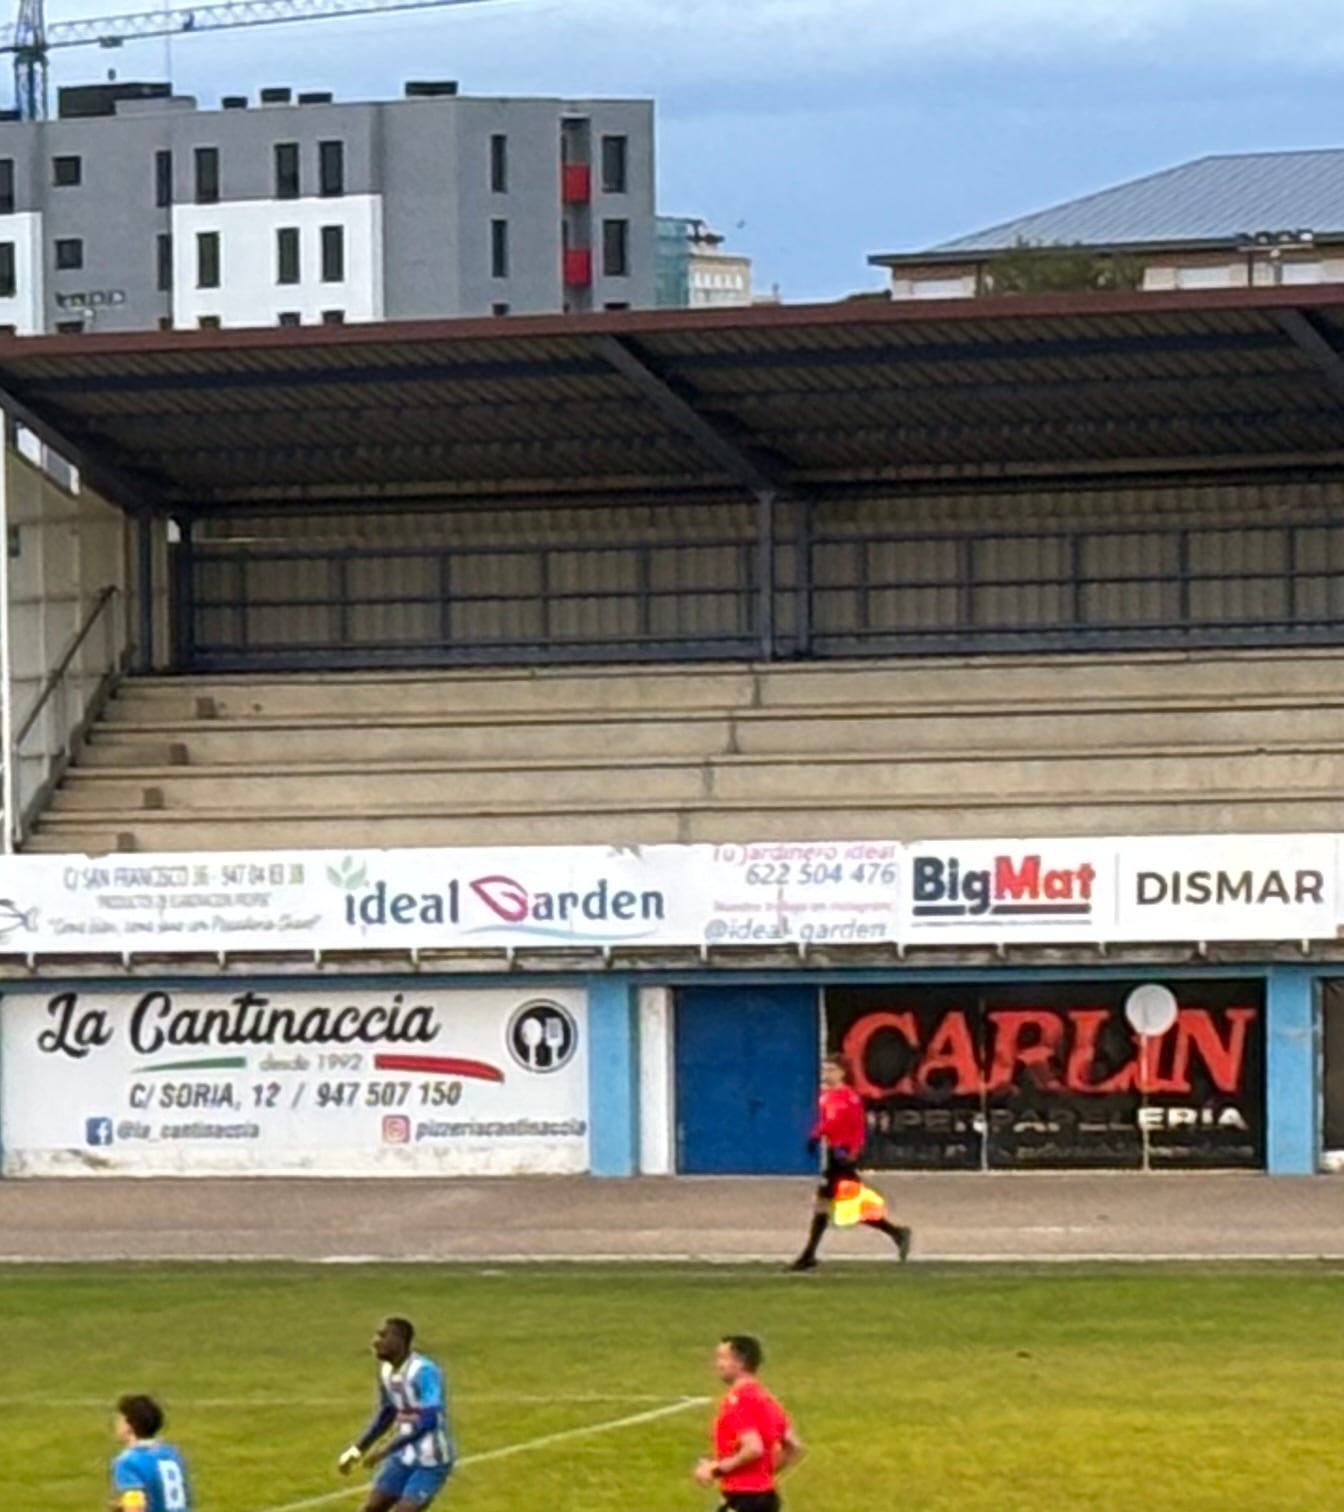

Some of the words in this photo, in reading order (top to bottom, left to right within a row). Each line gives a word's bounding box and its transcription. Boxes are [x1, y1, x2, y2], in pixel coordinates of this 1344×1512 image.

[745, 862, 791, 885] 622
[797, 862, 843, 885] 504
[850, 862, 897, 885] 476
[912, 855, 1096, 916] BigMat
[1135, 869, 1325, 906] DISMAR
[345, 878, 460, 926] ideal
[37, 990, 115, 1059] La
[130, 990, 443, 1055] Cantinaccia
[842, 1007, 1258, 1098] CARLIN
[129, 1082, 156, 1109] C/
[158, 1081, 242, 1111] SORIA,
[251, 1082, 282, 1108] 12
[316, 1081, 361, 1108] 947
[364, 1080, 411, 1107] 507
[418, 1080, 464, 1106] 150
